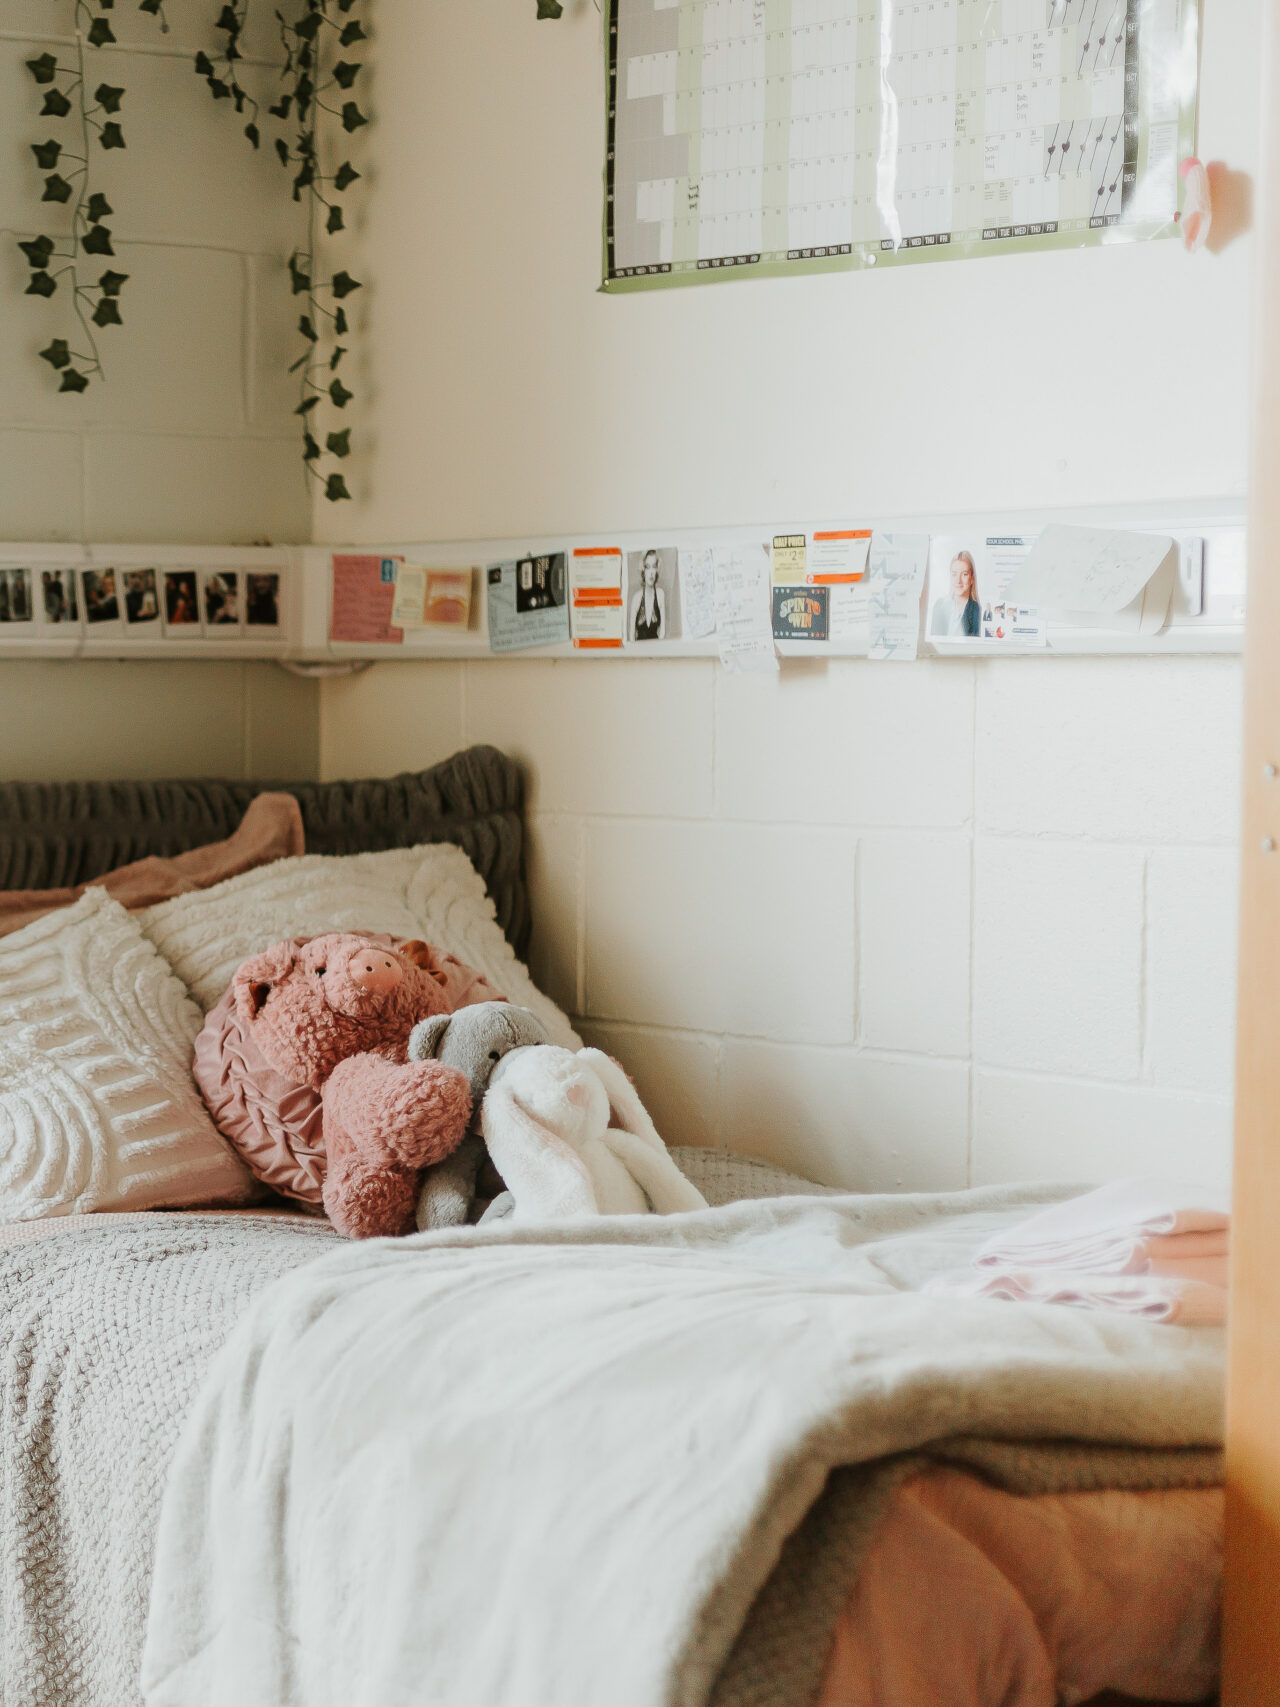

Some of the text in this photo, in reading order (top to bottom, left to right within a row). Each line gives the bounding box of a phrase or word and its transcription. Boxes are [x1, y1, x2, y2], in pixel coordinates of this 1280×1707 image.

[1124, 174, 1136, 182] DEC
[841, 246, 850, 254] FRI
[911, 238, 922, 246] WED
[925, 236, 935, 245] THU
[940, 235, 948, 243] FRI
[1000, 229, 1011, 237] TUE
[1014, 227, 1027, 236] WED
[1030, 225, 1041, 233] THU
[1046, 224, 1056, 232] FRI
[1091, 218, 1103, 226] MON
[1107, 216, 1118, 224] TUE
[780, 598, 820, 618] SPIN TO
[788, 612, 812, 628] WIN
